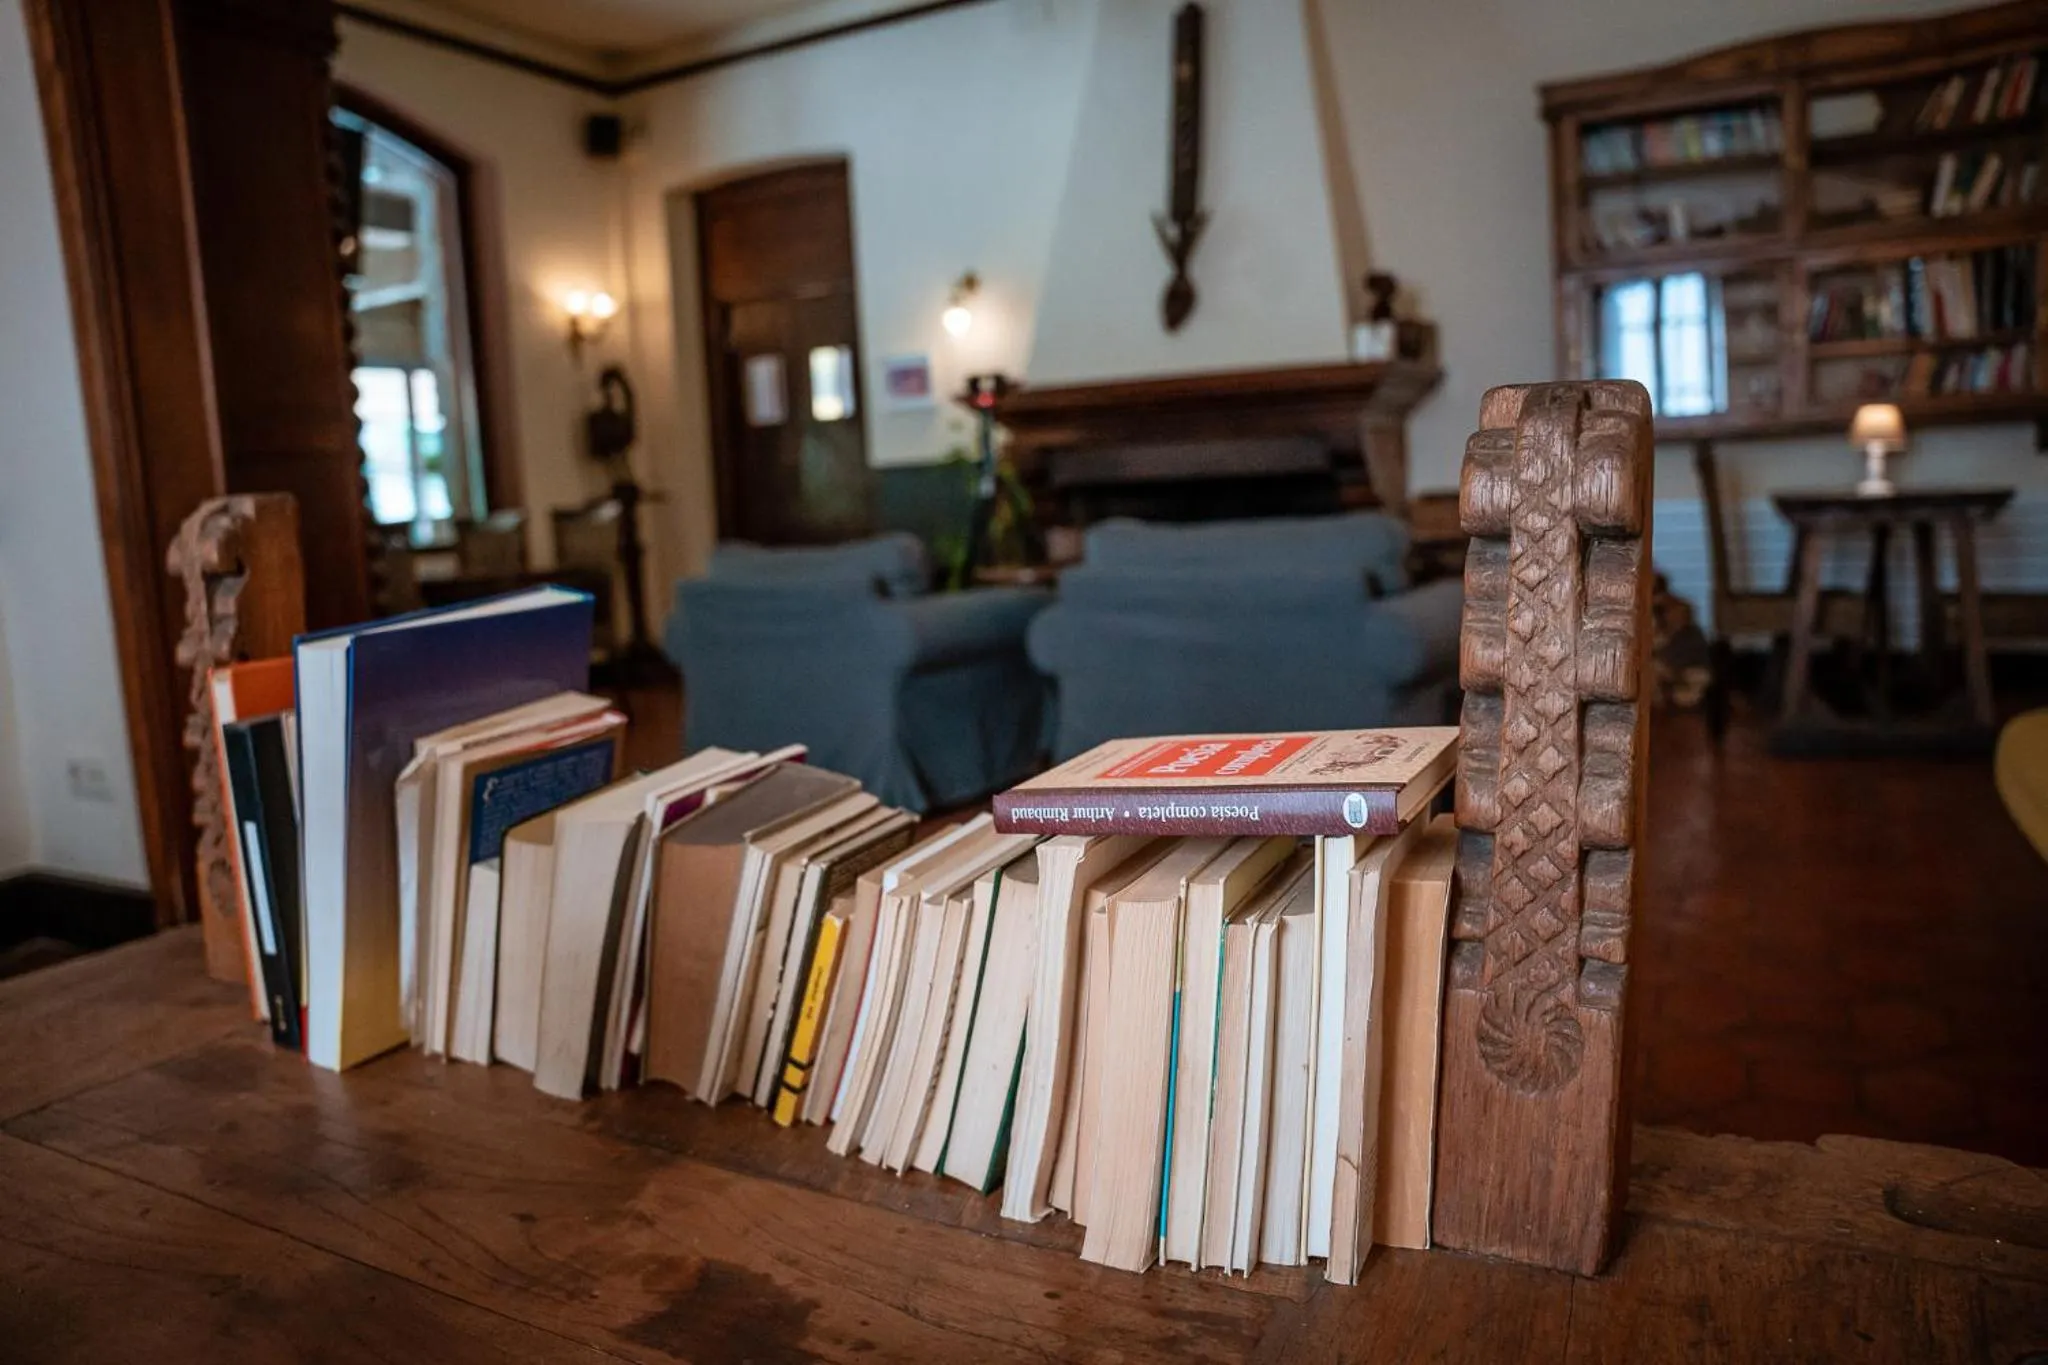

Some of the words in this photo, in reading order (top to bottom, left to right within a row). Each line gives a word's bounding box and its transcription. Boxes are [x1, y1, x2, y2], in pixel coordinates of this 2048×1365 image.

[1011, 807, 1069, 823] Rimbaud
[1072, 807, 1116, 822] Arthur
[1138, 803, 1207, 822] completa
[1211, 806, 1260, 822] Poesía
